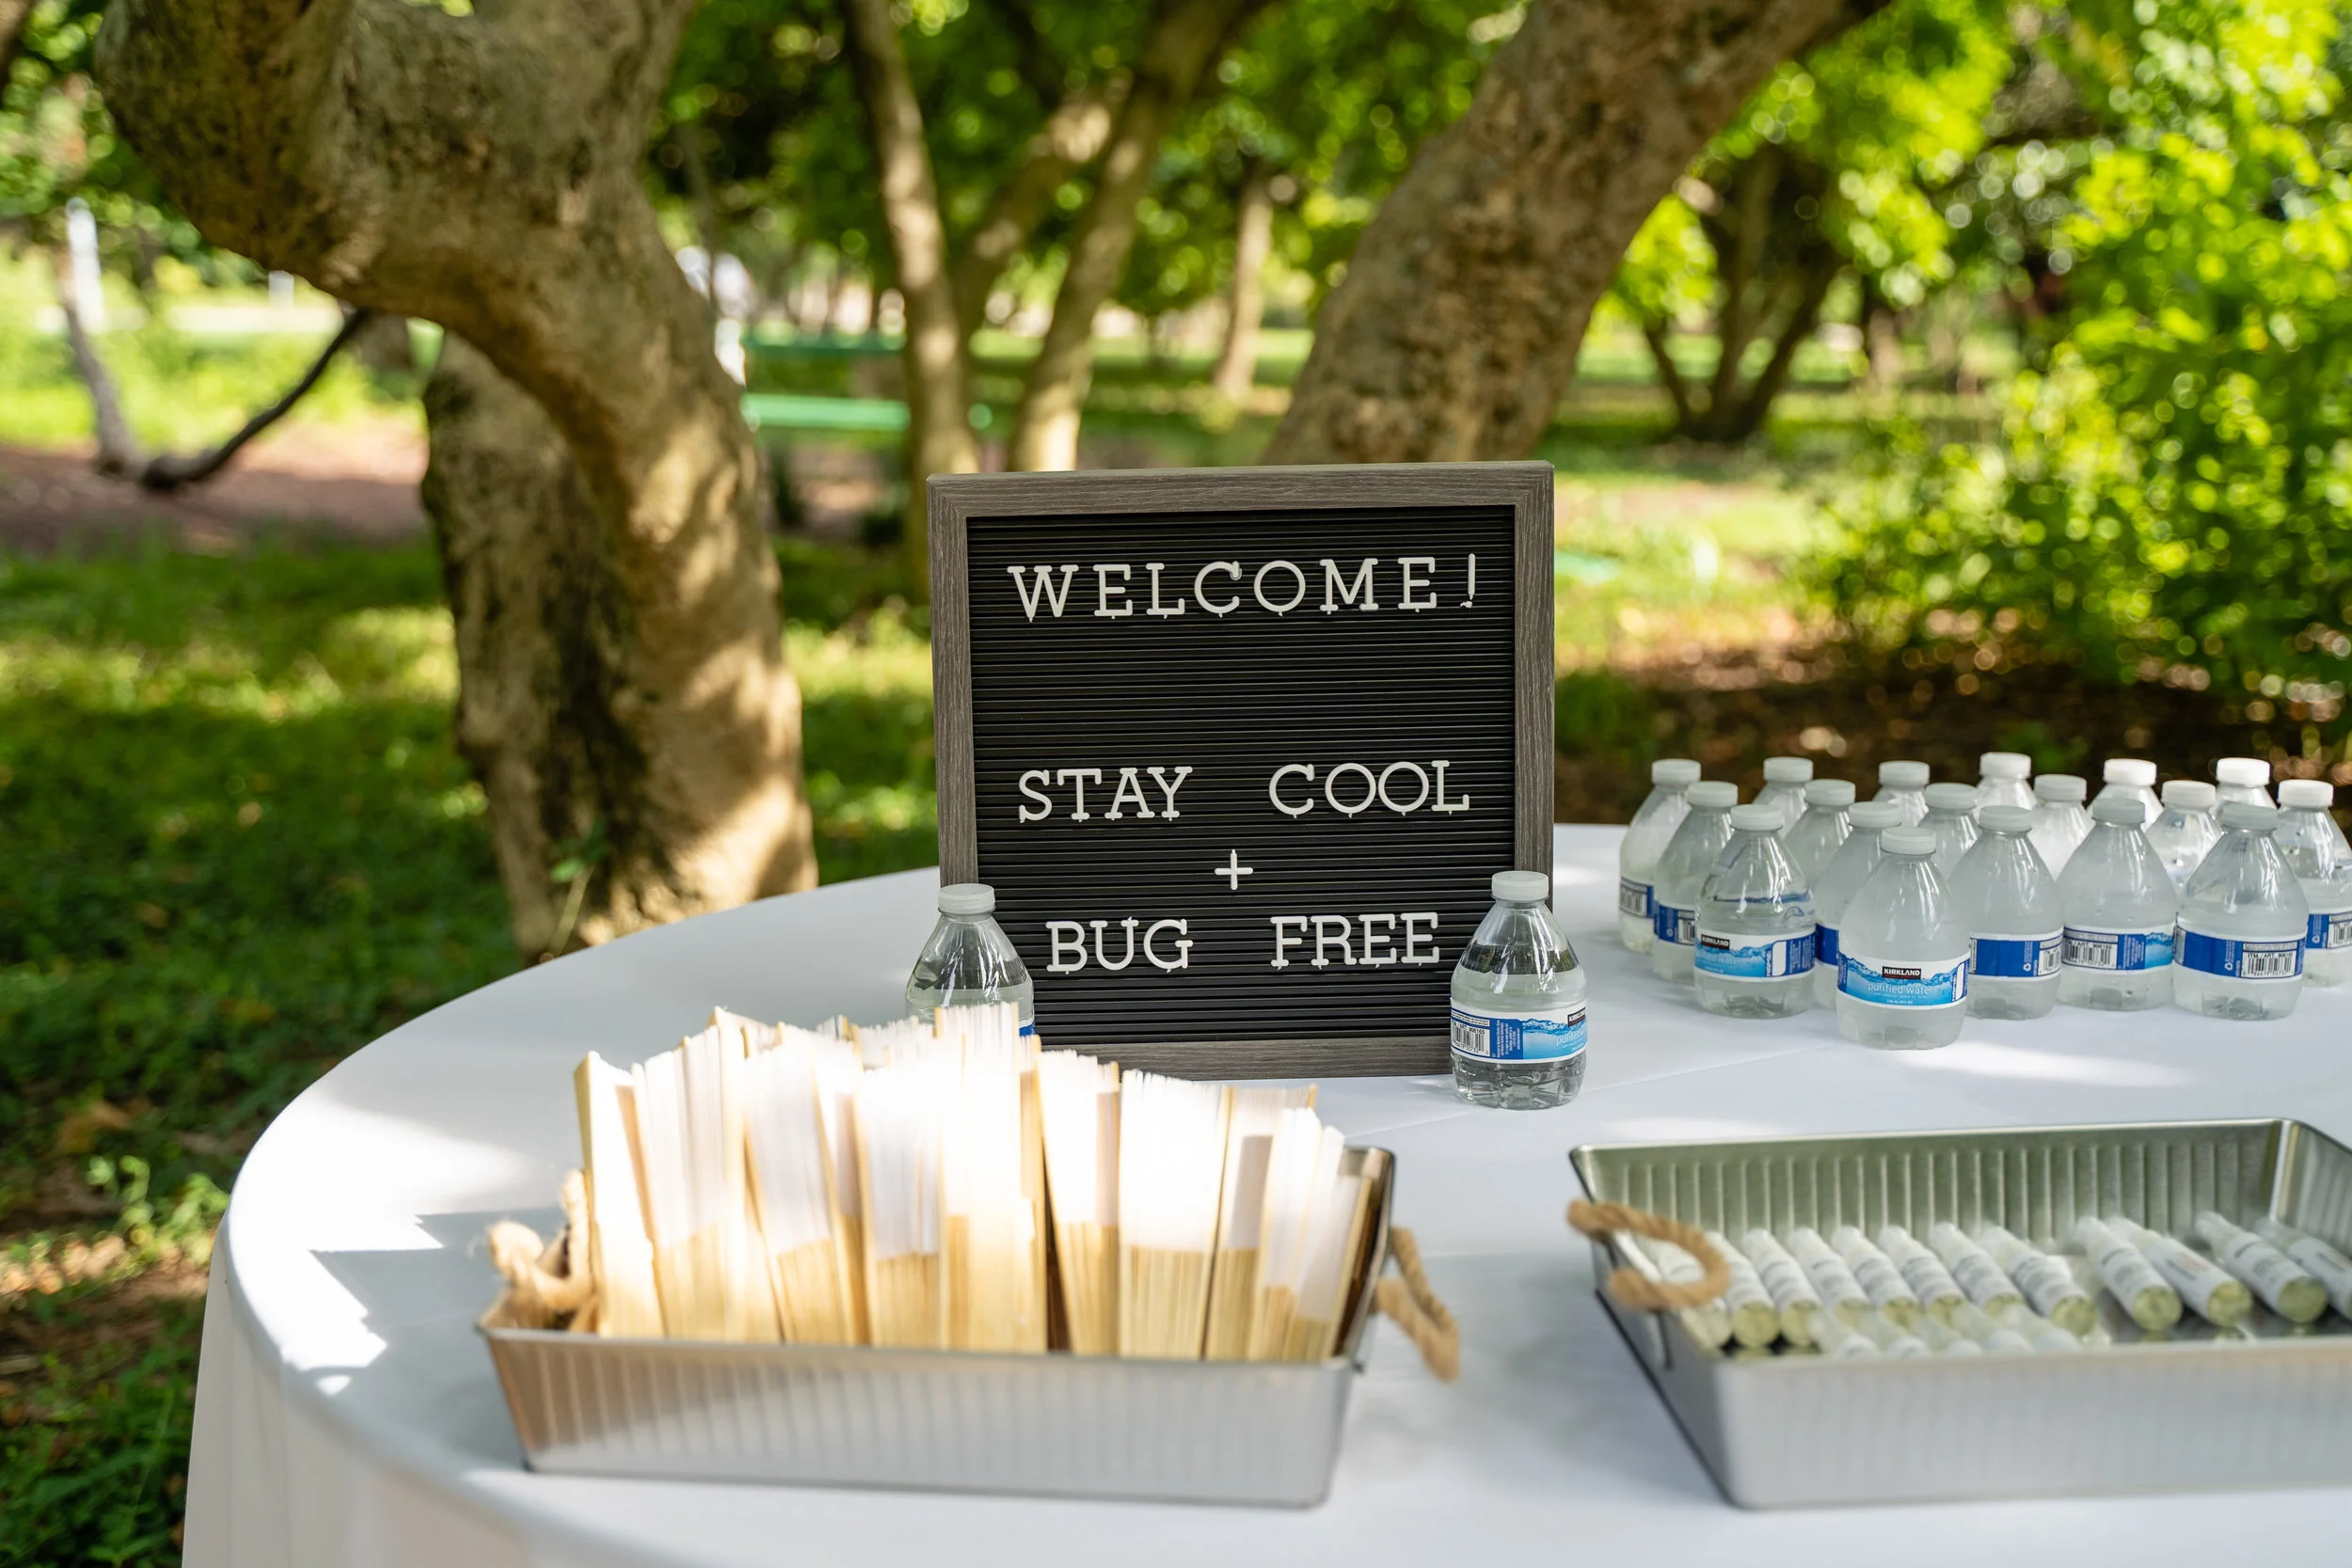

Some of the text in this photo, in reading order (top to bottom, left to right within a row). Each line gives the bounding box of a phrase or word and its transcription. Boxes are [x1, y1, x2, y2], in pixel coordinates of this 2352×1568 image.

[1007, 553, 1476, 623] WELCOME!
[1018, 759, 1470, 823] STAY COOL
[1045, 911, 1440, 974] BUG FREE
[1701, 936, 1729, 946] KIRKLAND
[1867, 983, 1932, 994] purified water
[1883, 968, 1920, 976] KIRKLAND
